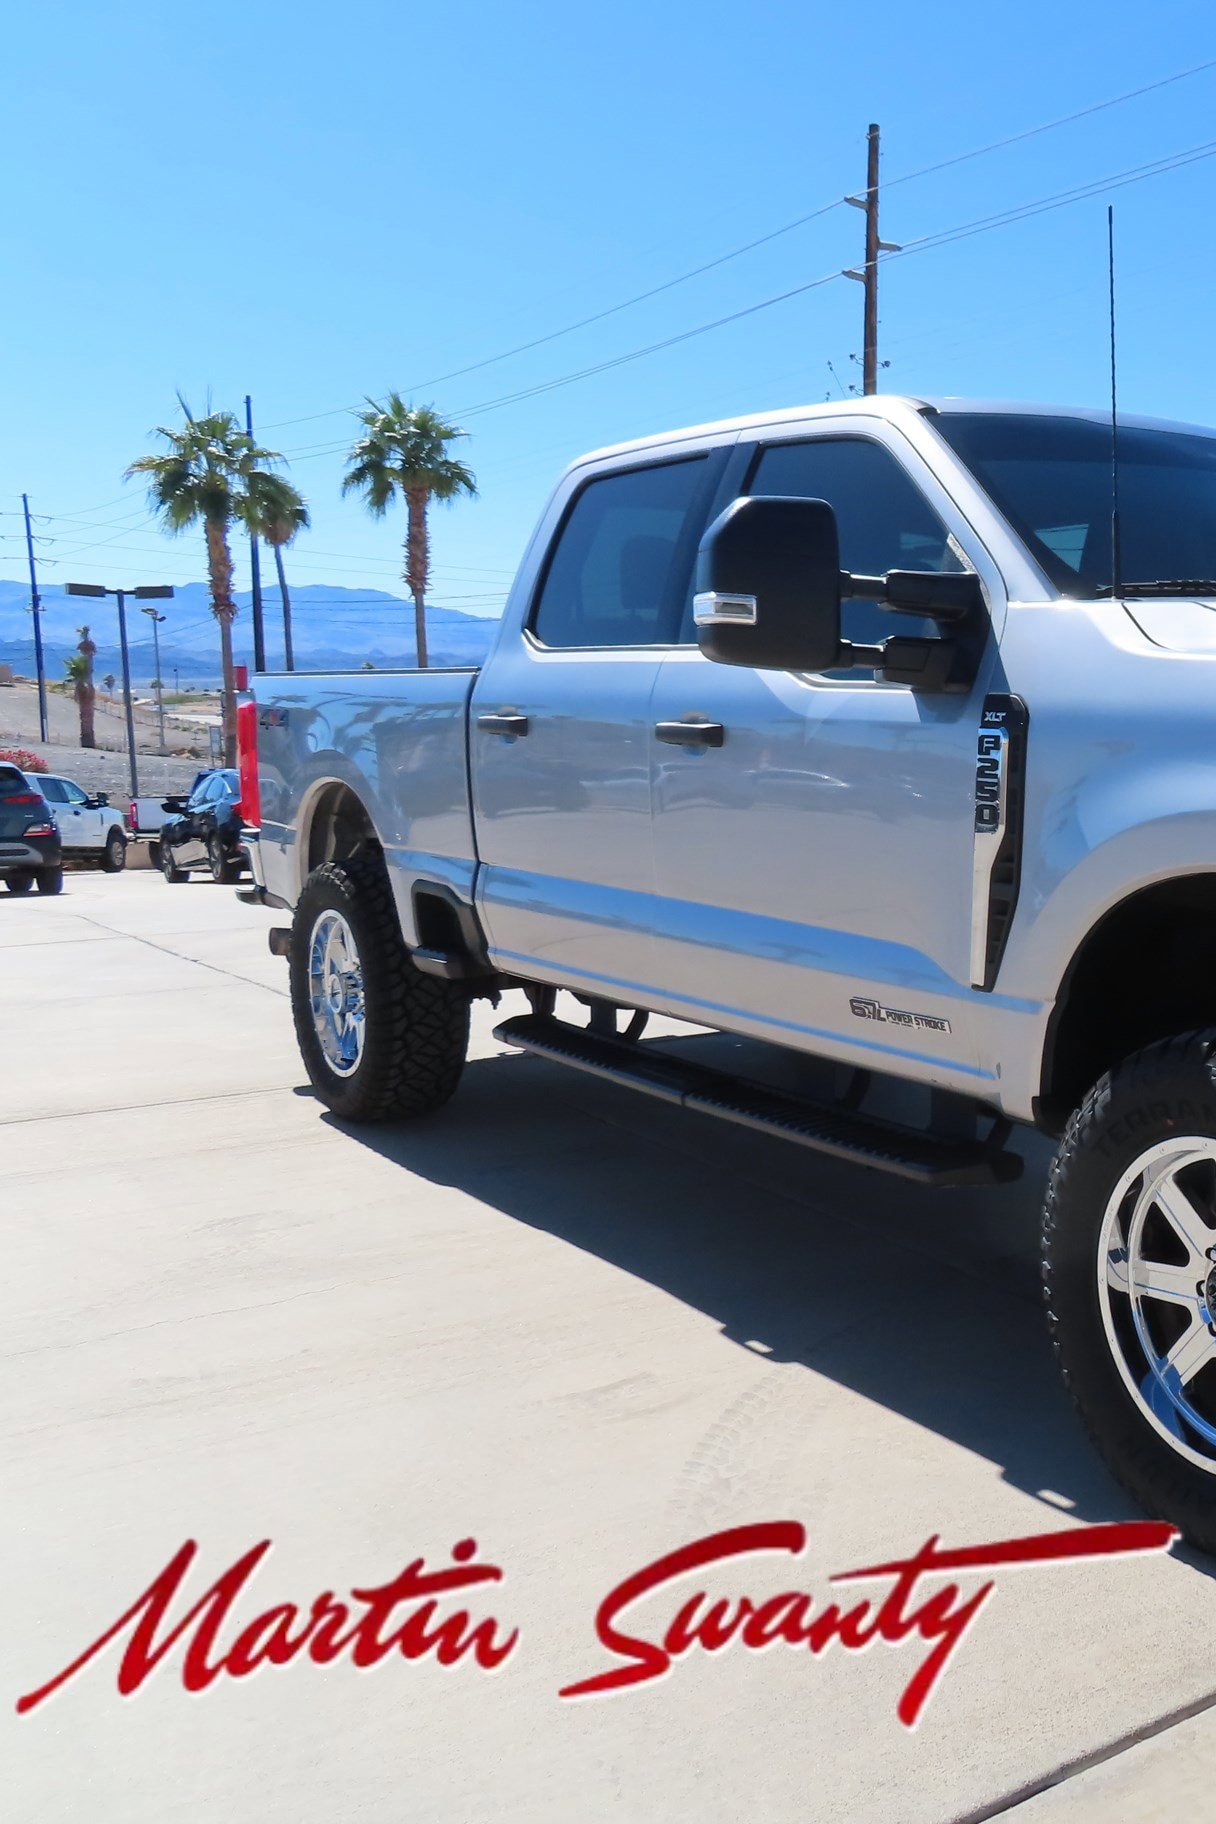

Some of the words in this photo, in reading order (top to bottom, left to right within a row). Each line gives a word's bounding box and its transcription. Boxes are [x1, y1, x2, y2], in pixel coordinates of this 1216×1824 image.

[984, 711, 1007, 722] XLT
[885, 1009, 914, 1025] POWER
[914, 1016, 947, 1032] STROKE
